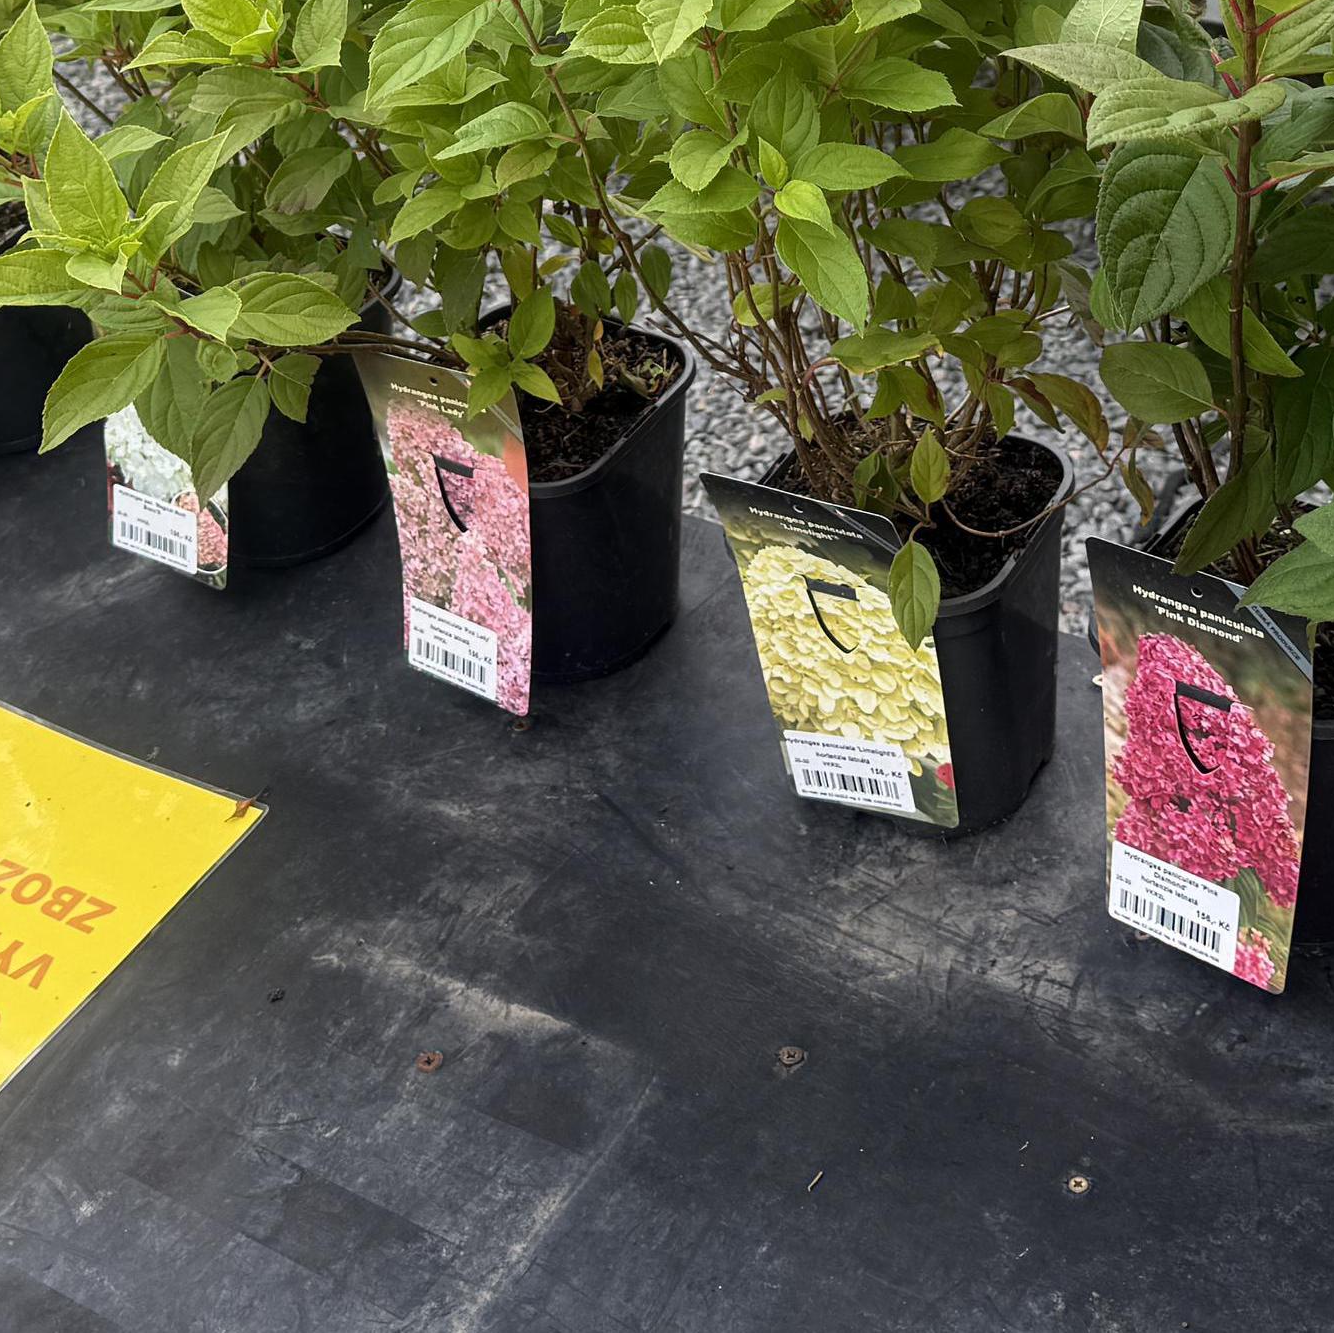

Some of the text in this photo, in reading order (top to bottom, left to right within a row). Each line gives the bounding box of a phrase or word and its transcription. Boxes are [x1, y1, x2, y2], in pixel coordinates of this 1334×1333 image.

[390, 382, 438, 401] Hydrangea
[441, 405, 465, 419] Lady'
[748, 506, 864, 540] Hydrangea paniculata
[1132, 584, 1265, 639] Hydrangea paniculata
[1154, 604, 1244, 644] 'Pink Diamond'
[1218, 919, 1231, 932] Kč
